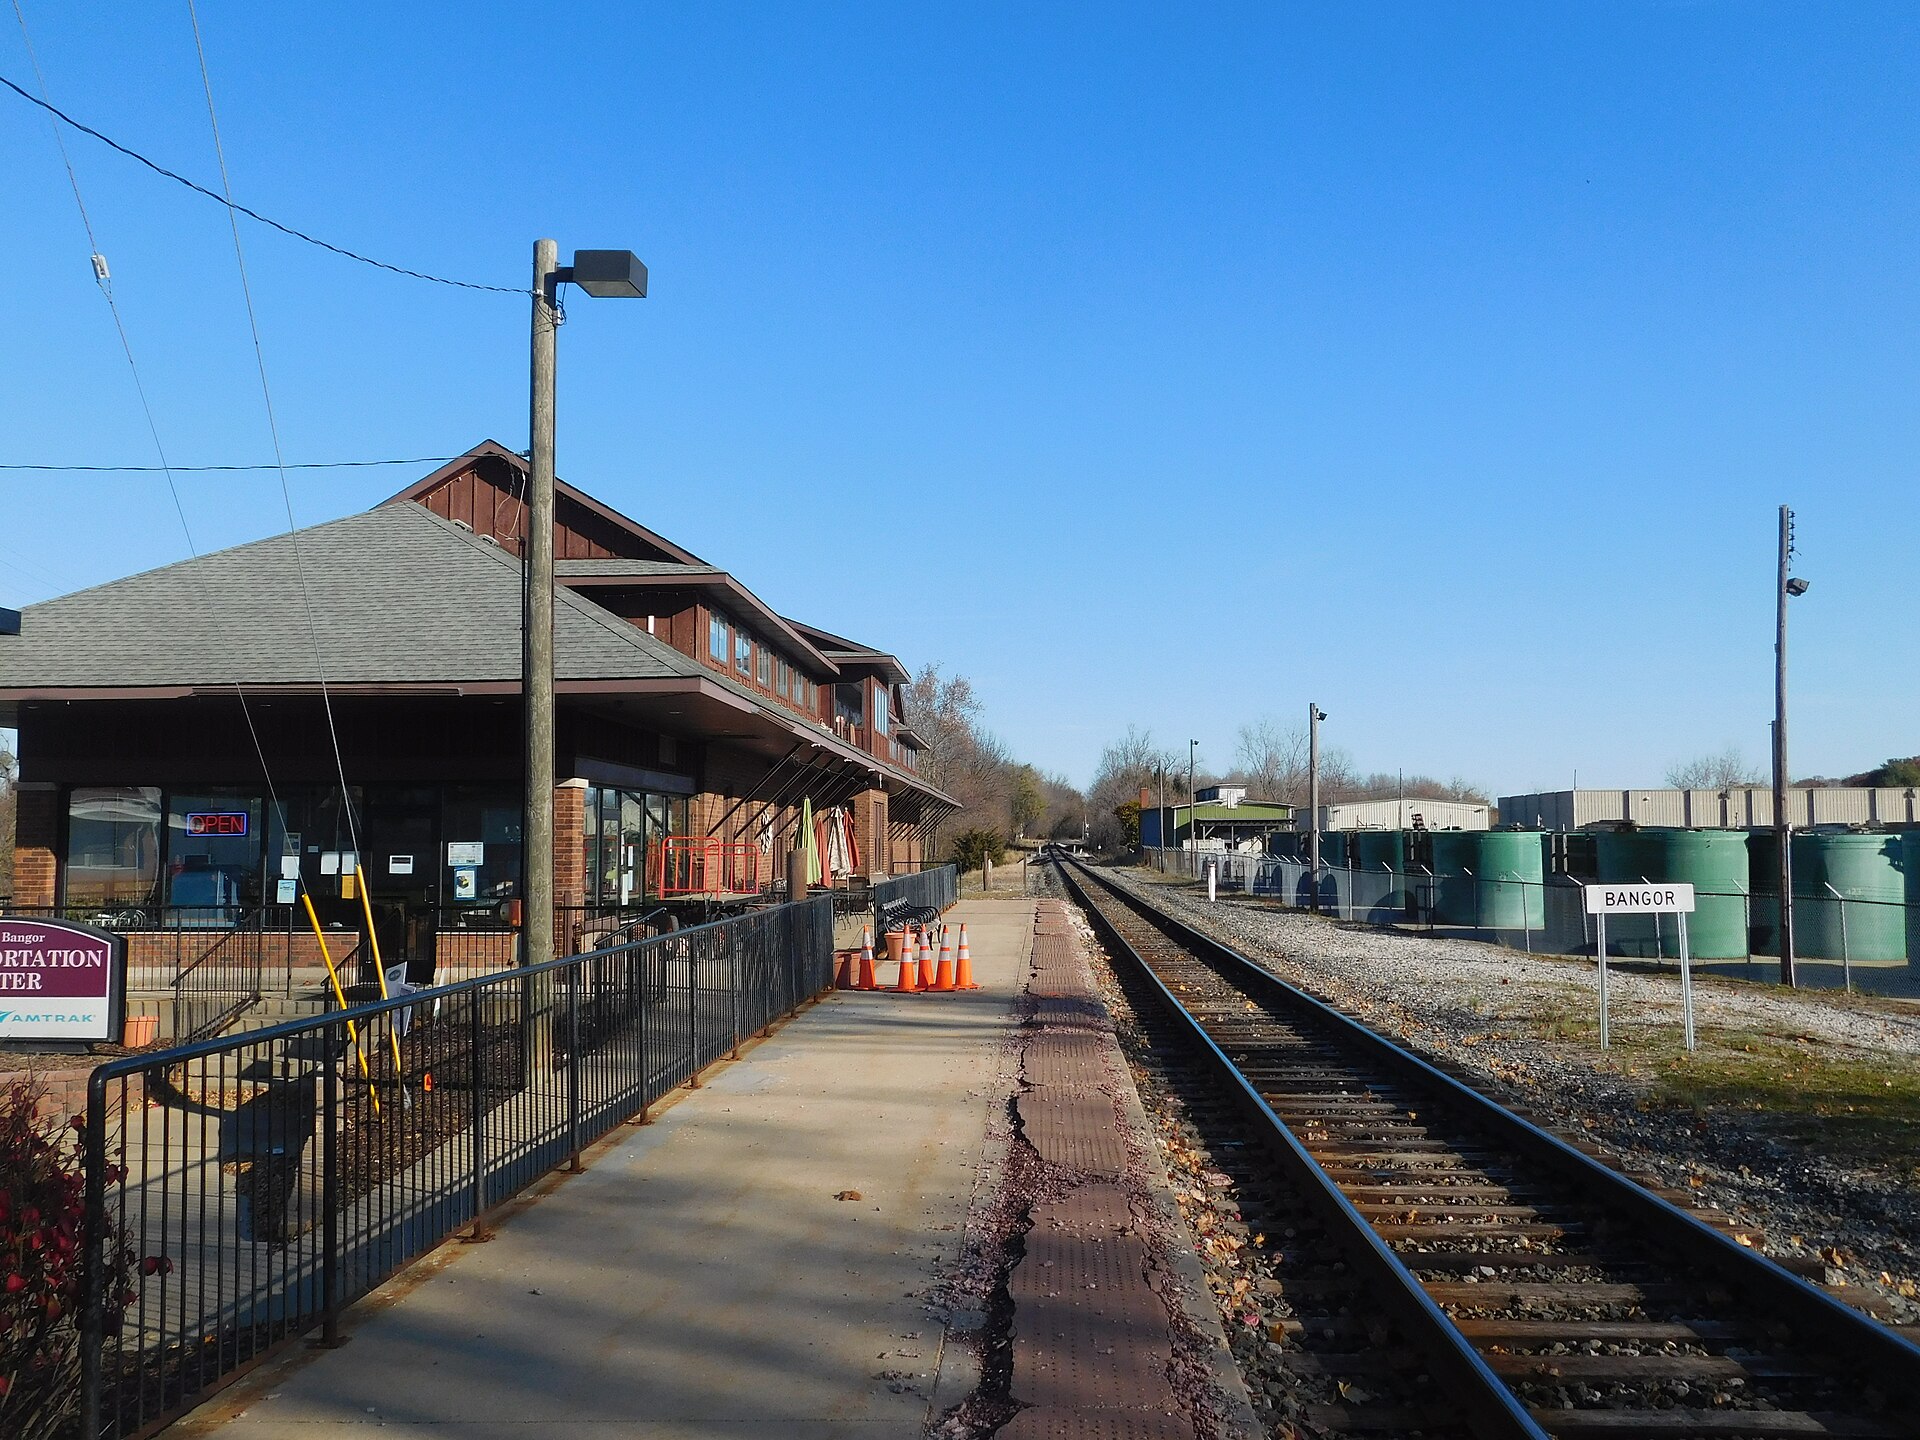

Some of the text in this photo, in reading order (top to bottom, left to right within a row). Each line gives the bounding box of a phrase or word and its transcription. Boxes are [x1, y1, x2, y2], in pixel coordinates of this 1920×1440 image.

[190, 815, 244, 833] OPEN
[1605, 891, 1675, 906] BANGOR
[2, 932, 45, 944] Bangor
[0, 972, 42, 990] TER
[12, 1014, 93, 1022] AMTRAK
